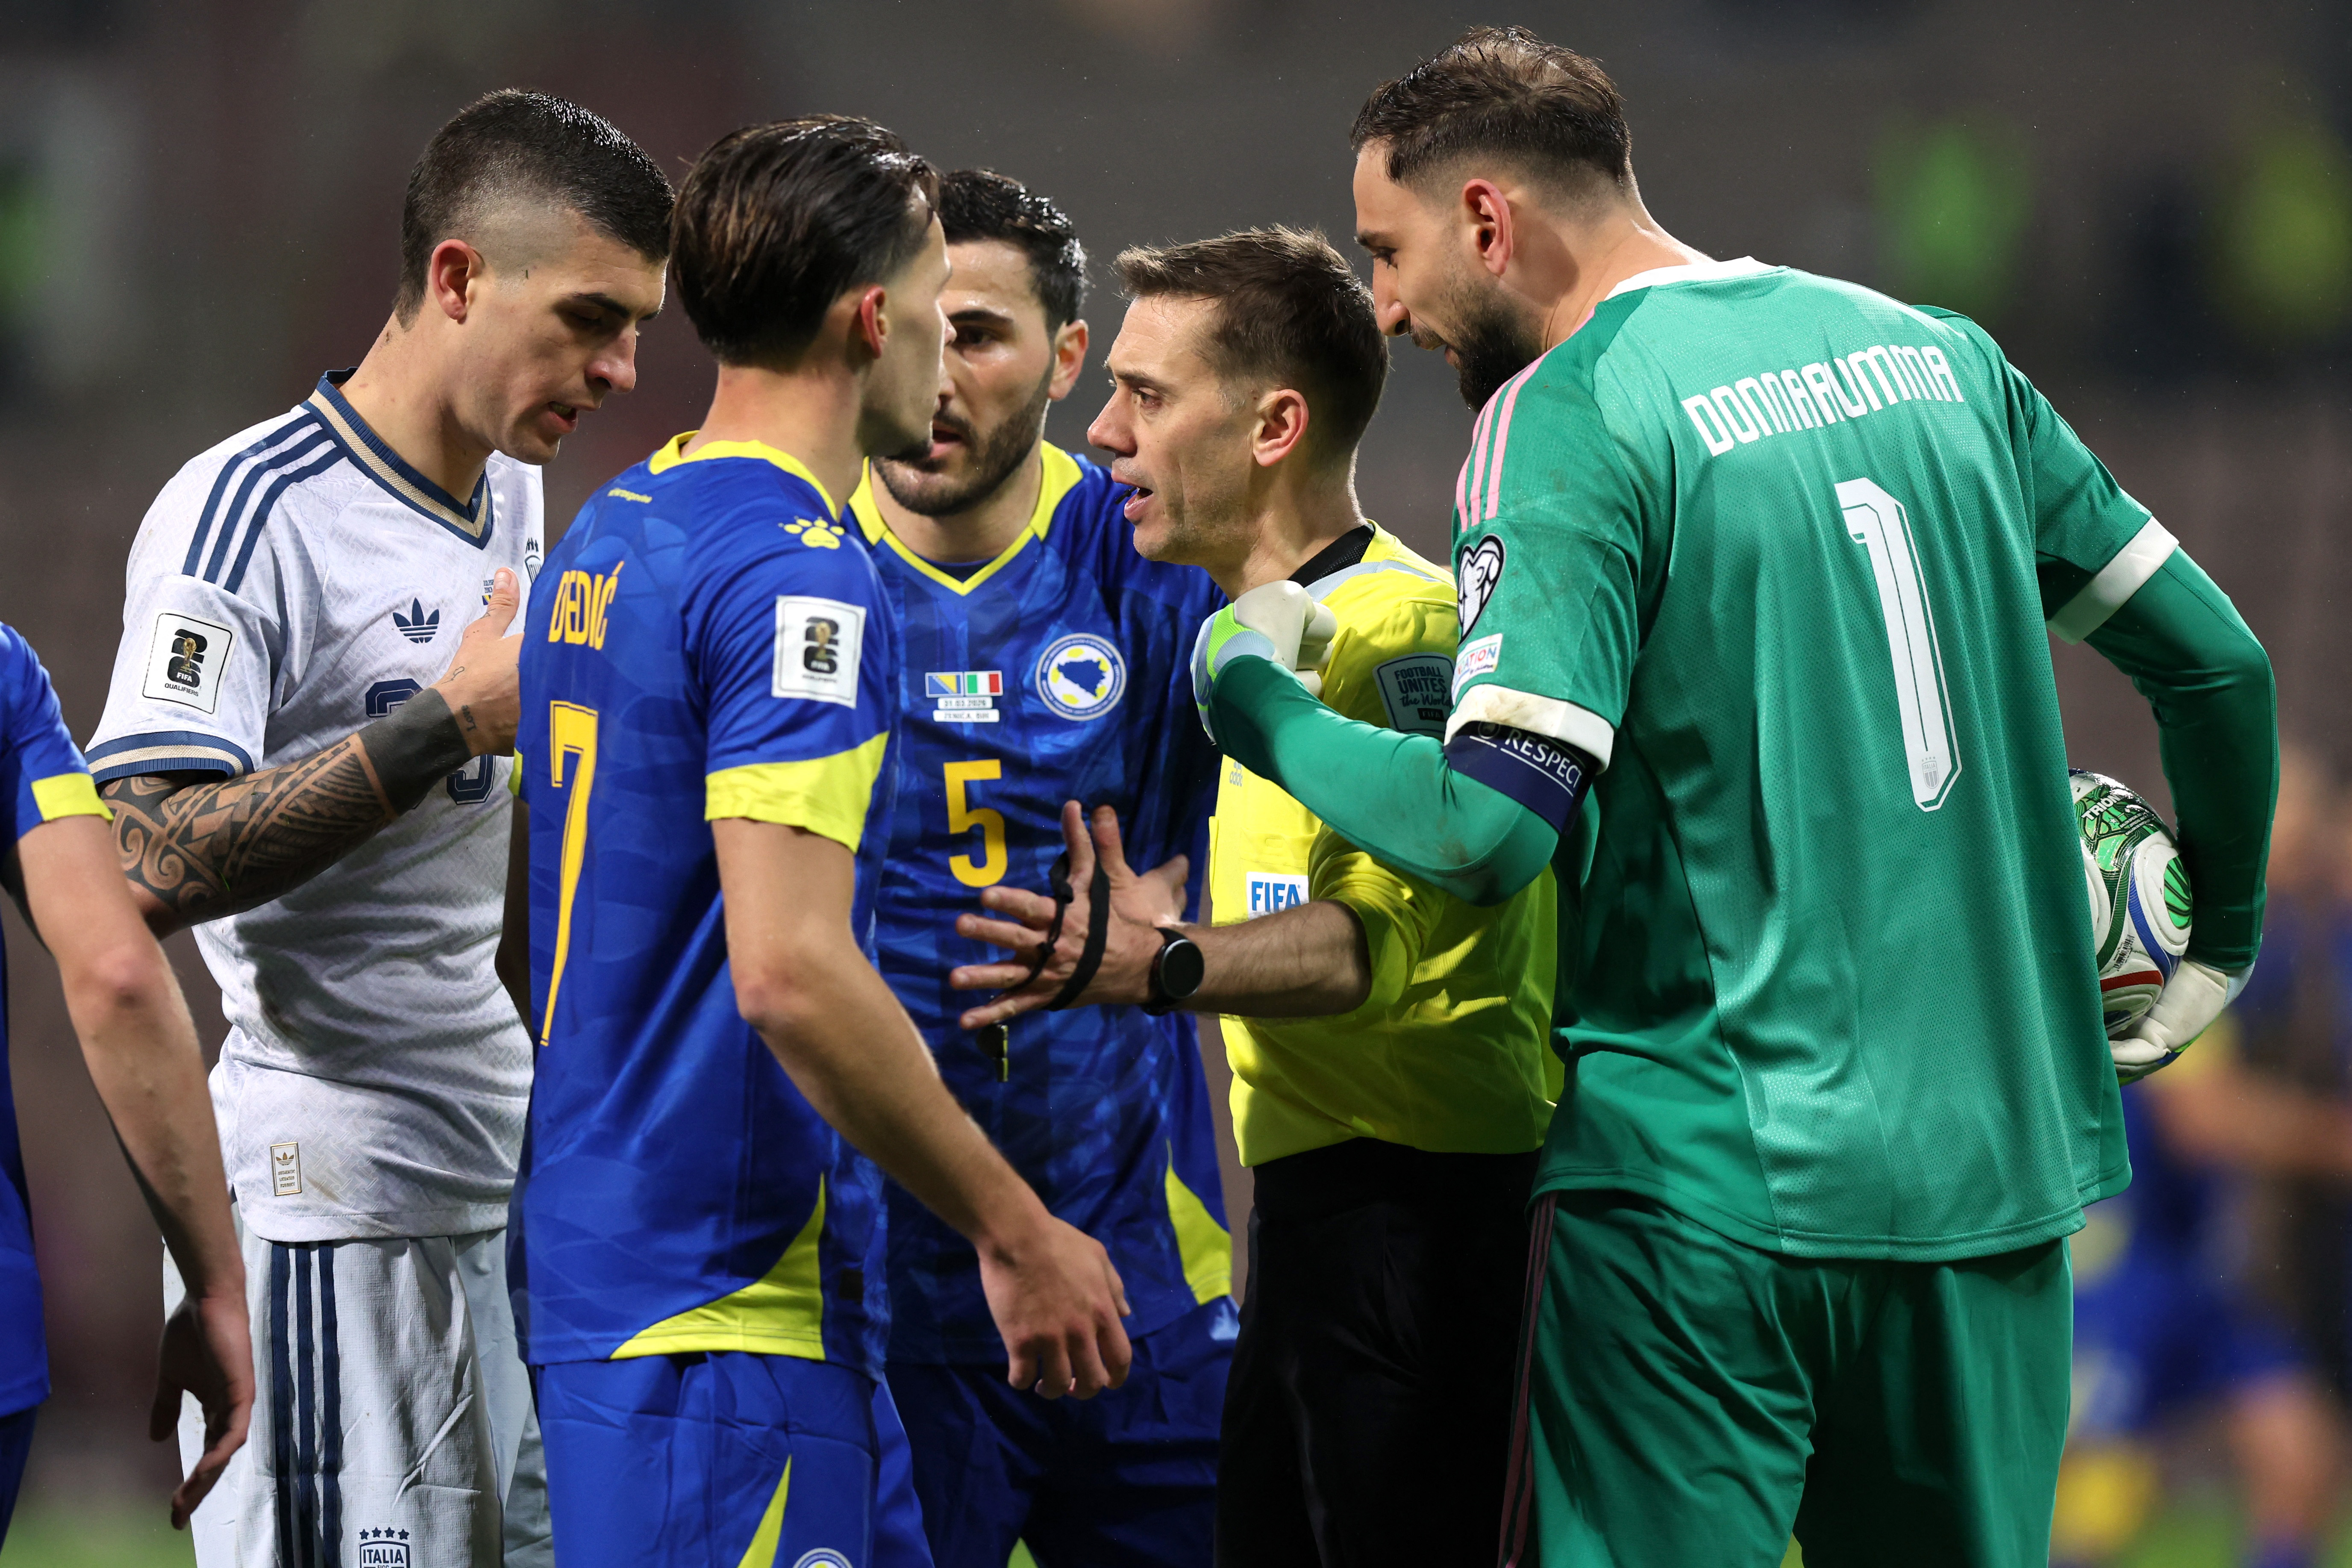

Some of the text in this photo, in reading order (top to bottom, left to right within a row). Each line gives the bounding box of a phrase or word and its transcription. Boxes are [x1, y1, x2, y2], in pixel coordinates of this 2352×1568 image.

[1680, 344, 1965, 457] DONNARUMMA
[548, 561, 625, 651] DEDIĆ
[1834, 477, 1962, 812] 1
[176, 672, 192, 683] FIFA
[1394, 666, 1444, 680] FOOTBALL
[1397, 677, 1447, 694] UNITES
[165, 683, 199, 697] QUALIFIERS
[1399, 693, 1420, 707] the
[1504, 728, 1582, 788] RESPECT
[2081, 793, 2122, 821] TRION
[943, 759, 1008, 888] 5
[541, 700, 598, 1046] 7
[1252, 881, 1301, 912] FIFA
[363, 1549, 404, 1564] ITALIA
